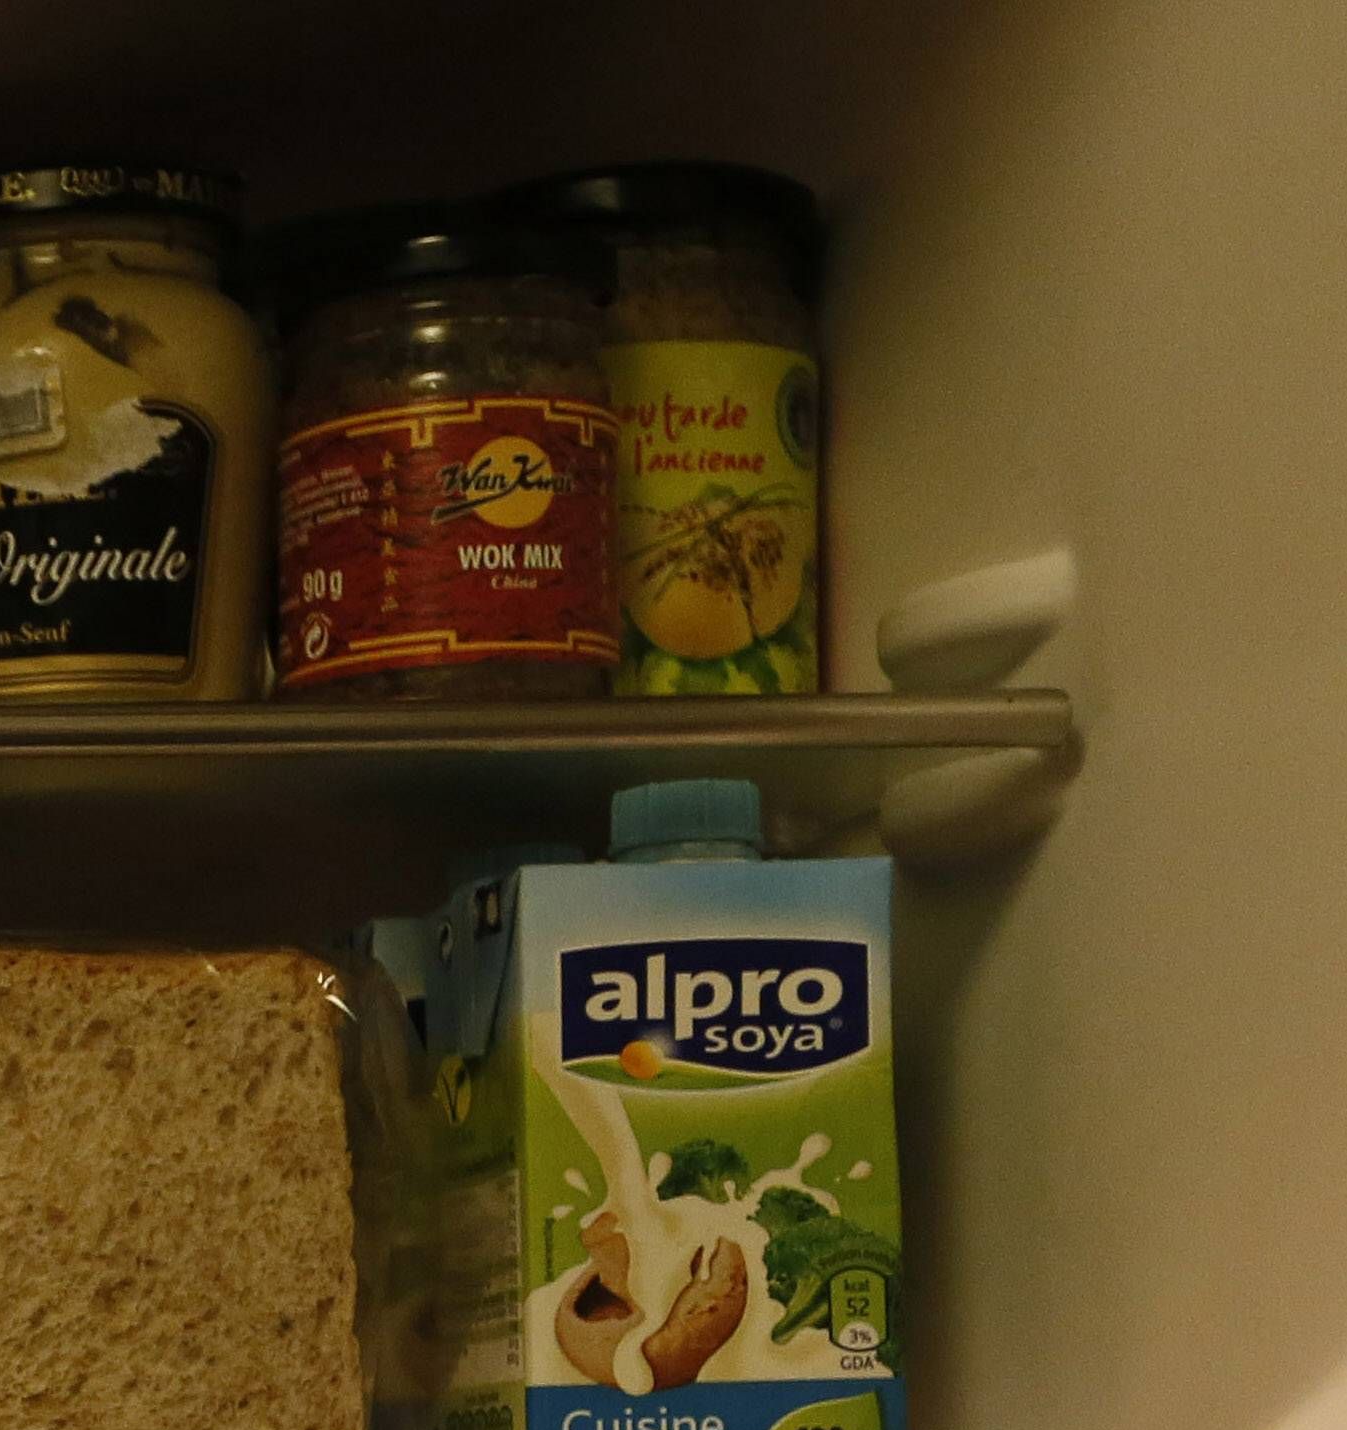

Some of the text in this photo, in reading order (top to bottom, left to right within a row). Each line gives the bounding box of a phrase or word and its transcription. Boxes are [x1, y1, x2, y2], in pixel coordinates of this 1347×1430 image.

[458, 544, 563, 570] WOK MIX
[585, 953, 844, 1042] alpro
[704, 1023, 825, 1059] soya
[842, 1279, 871, 1293] kcal
[845, 1299, 870, 1318] 52
[849, 1329, 873, 1345] 3%
